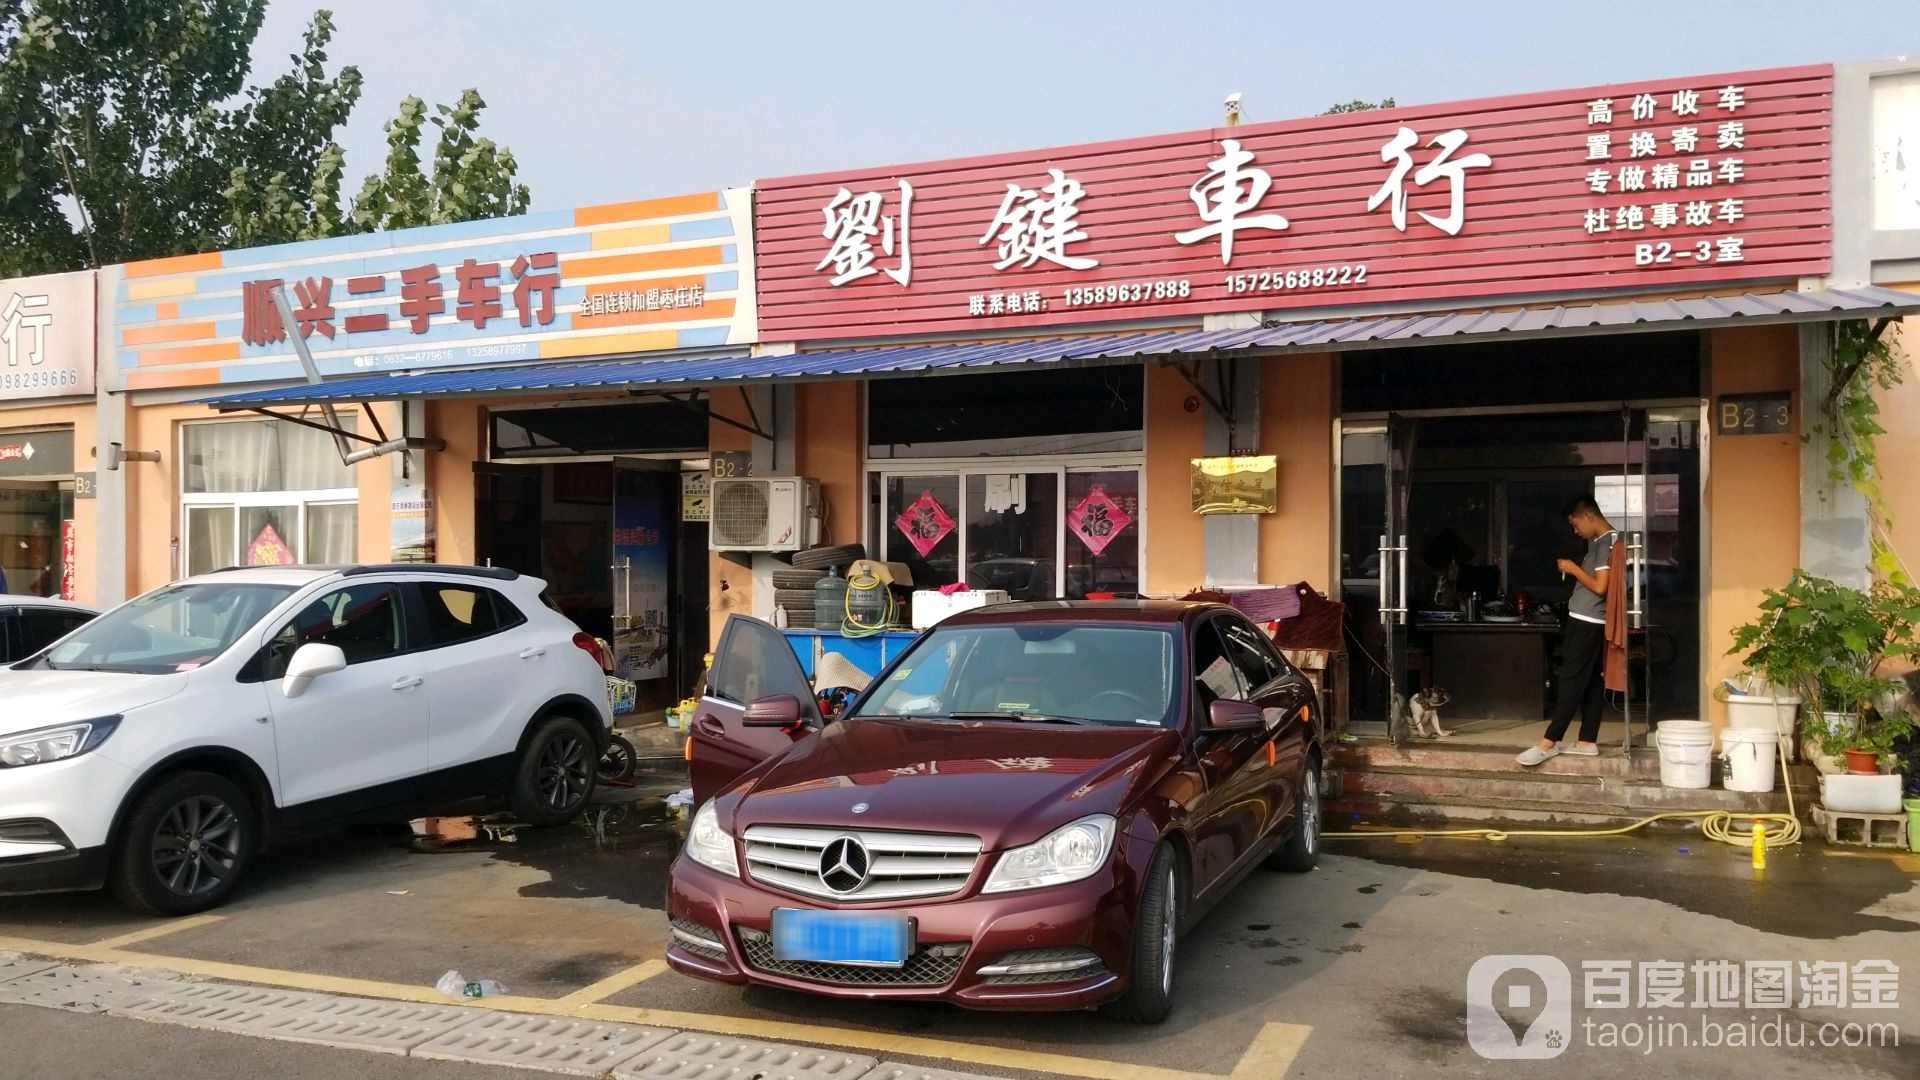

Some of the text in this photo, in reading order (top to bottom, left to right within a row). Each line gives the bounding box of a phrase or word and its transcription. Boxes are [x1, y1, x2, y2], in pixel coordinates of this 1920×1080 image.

[1587, 85, 1745, 125] 高价收车
[1585, 121, 1745, 161] 置换寄卖
[1585, 157, 1745, 194] 专做精品车
[1584, 198, 1745, 234] 杜绝事故车
[1635, 236, 1745, 266] B2-3室
[242, 251, 561, 348] 顺兴二手车行
[579, 284, 703, 317] 全国连锁加盟枣庄店
[1063, 279, 1191, 307] 13589637888
[1224, 264, 1368, 293] 15725688222
[1, 293, 52, 367] 行
[466, 343, 527, 358] 13258977997
[0, 370, 77, 389] 98299666
[1721, 403, 1789, 429] B2-3
